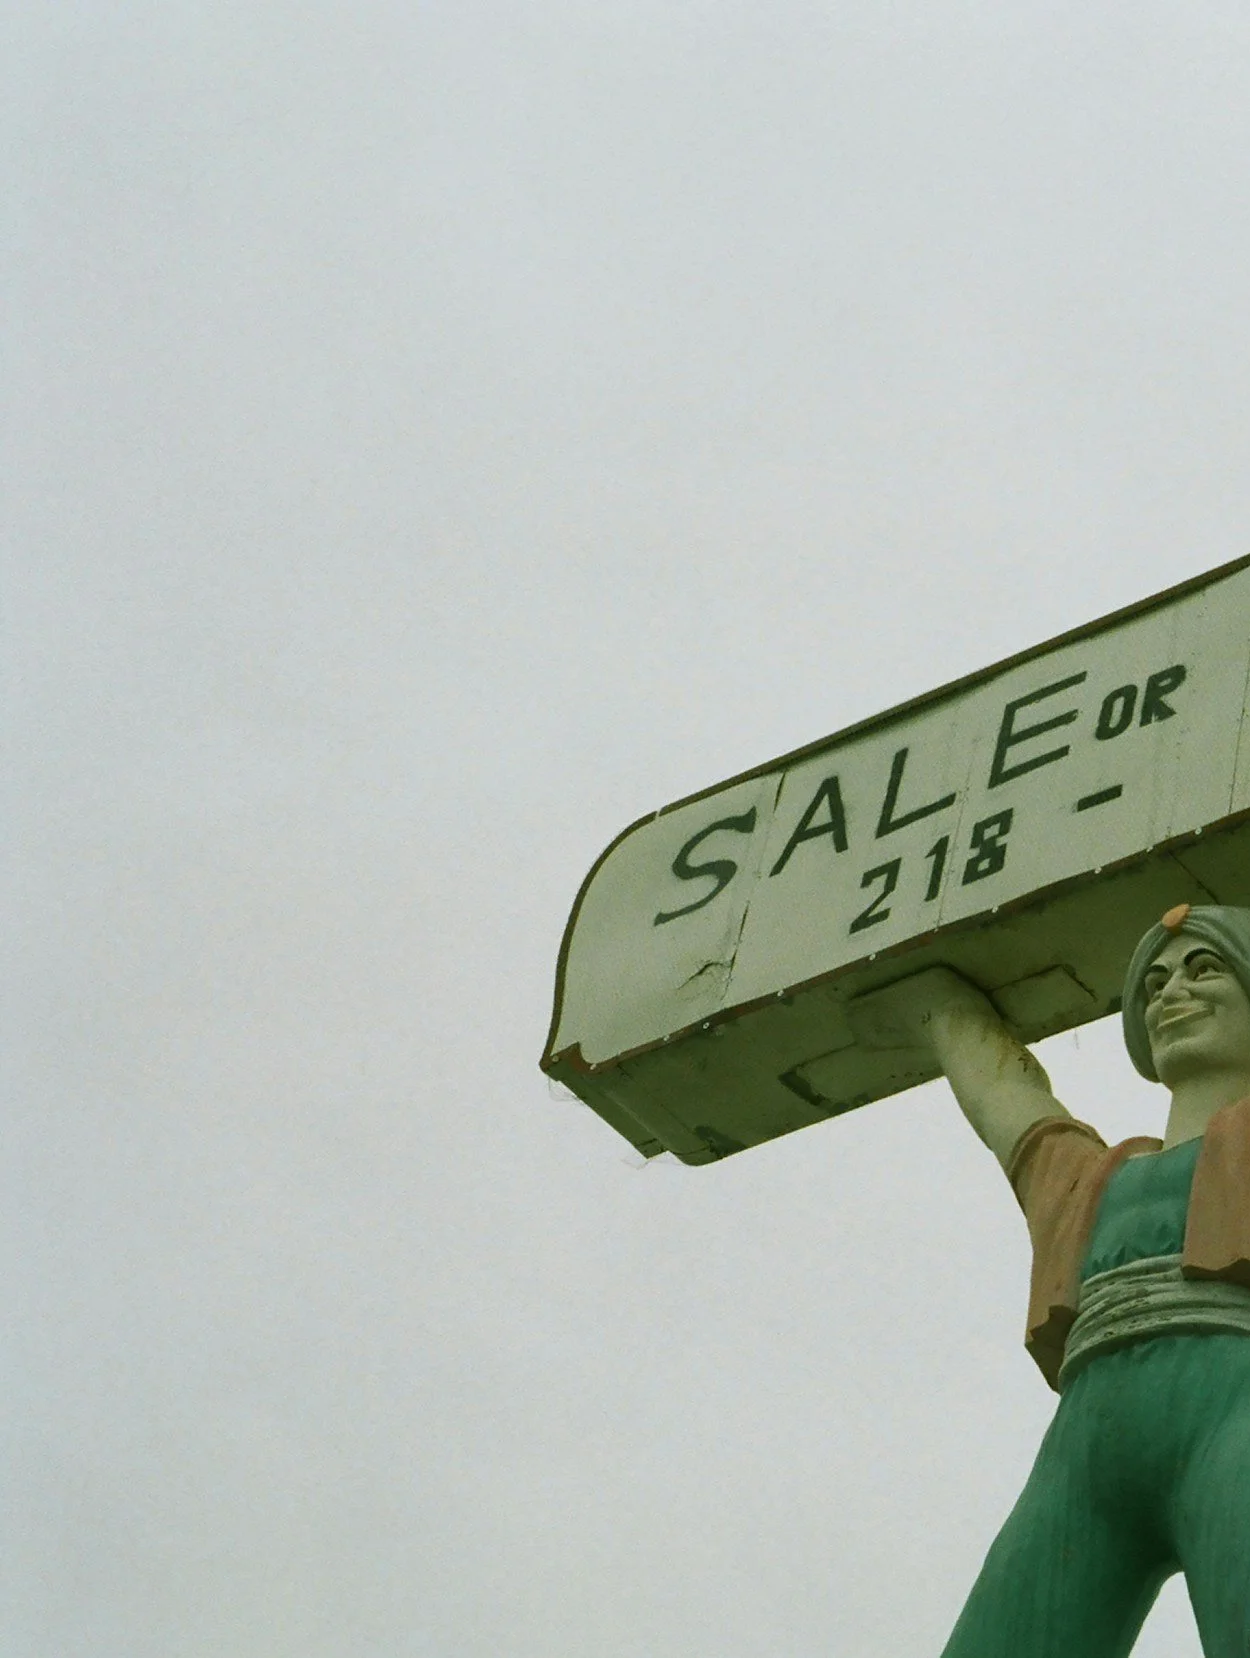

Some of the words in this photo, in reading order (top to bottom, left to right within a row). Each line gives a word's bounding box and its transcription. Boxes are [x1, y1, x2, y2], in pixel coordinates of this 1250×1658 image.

[653, 670, 1088, 927] SALE
[1094, 664, 1188, 742] OR
[848, 807, 1014, 935] 218
